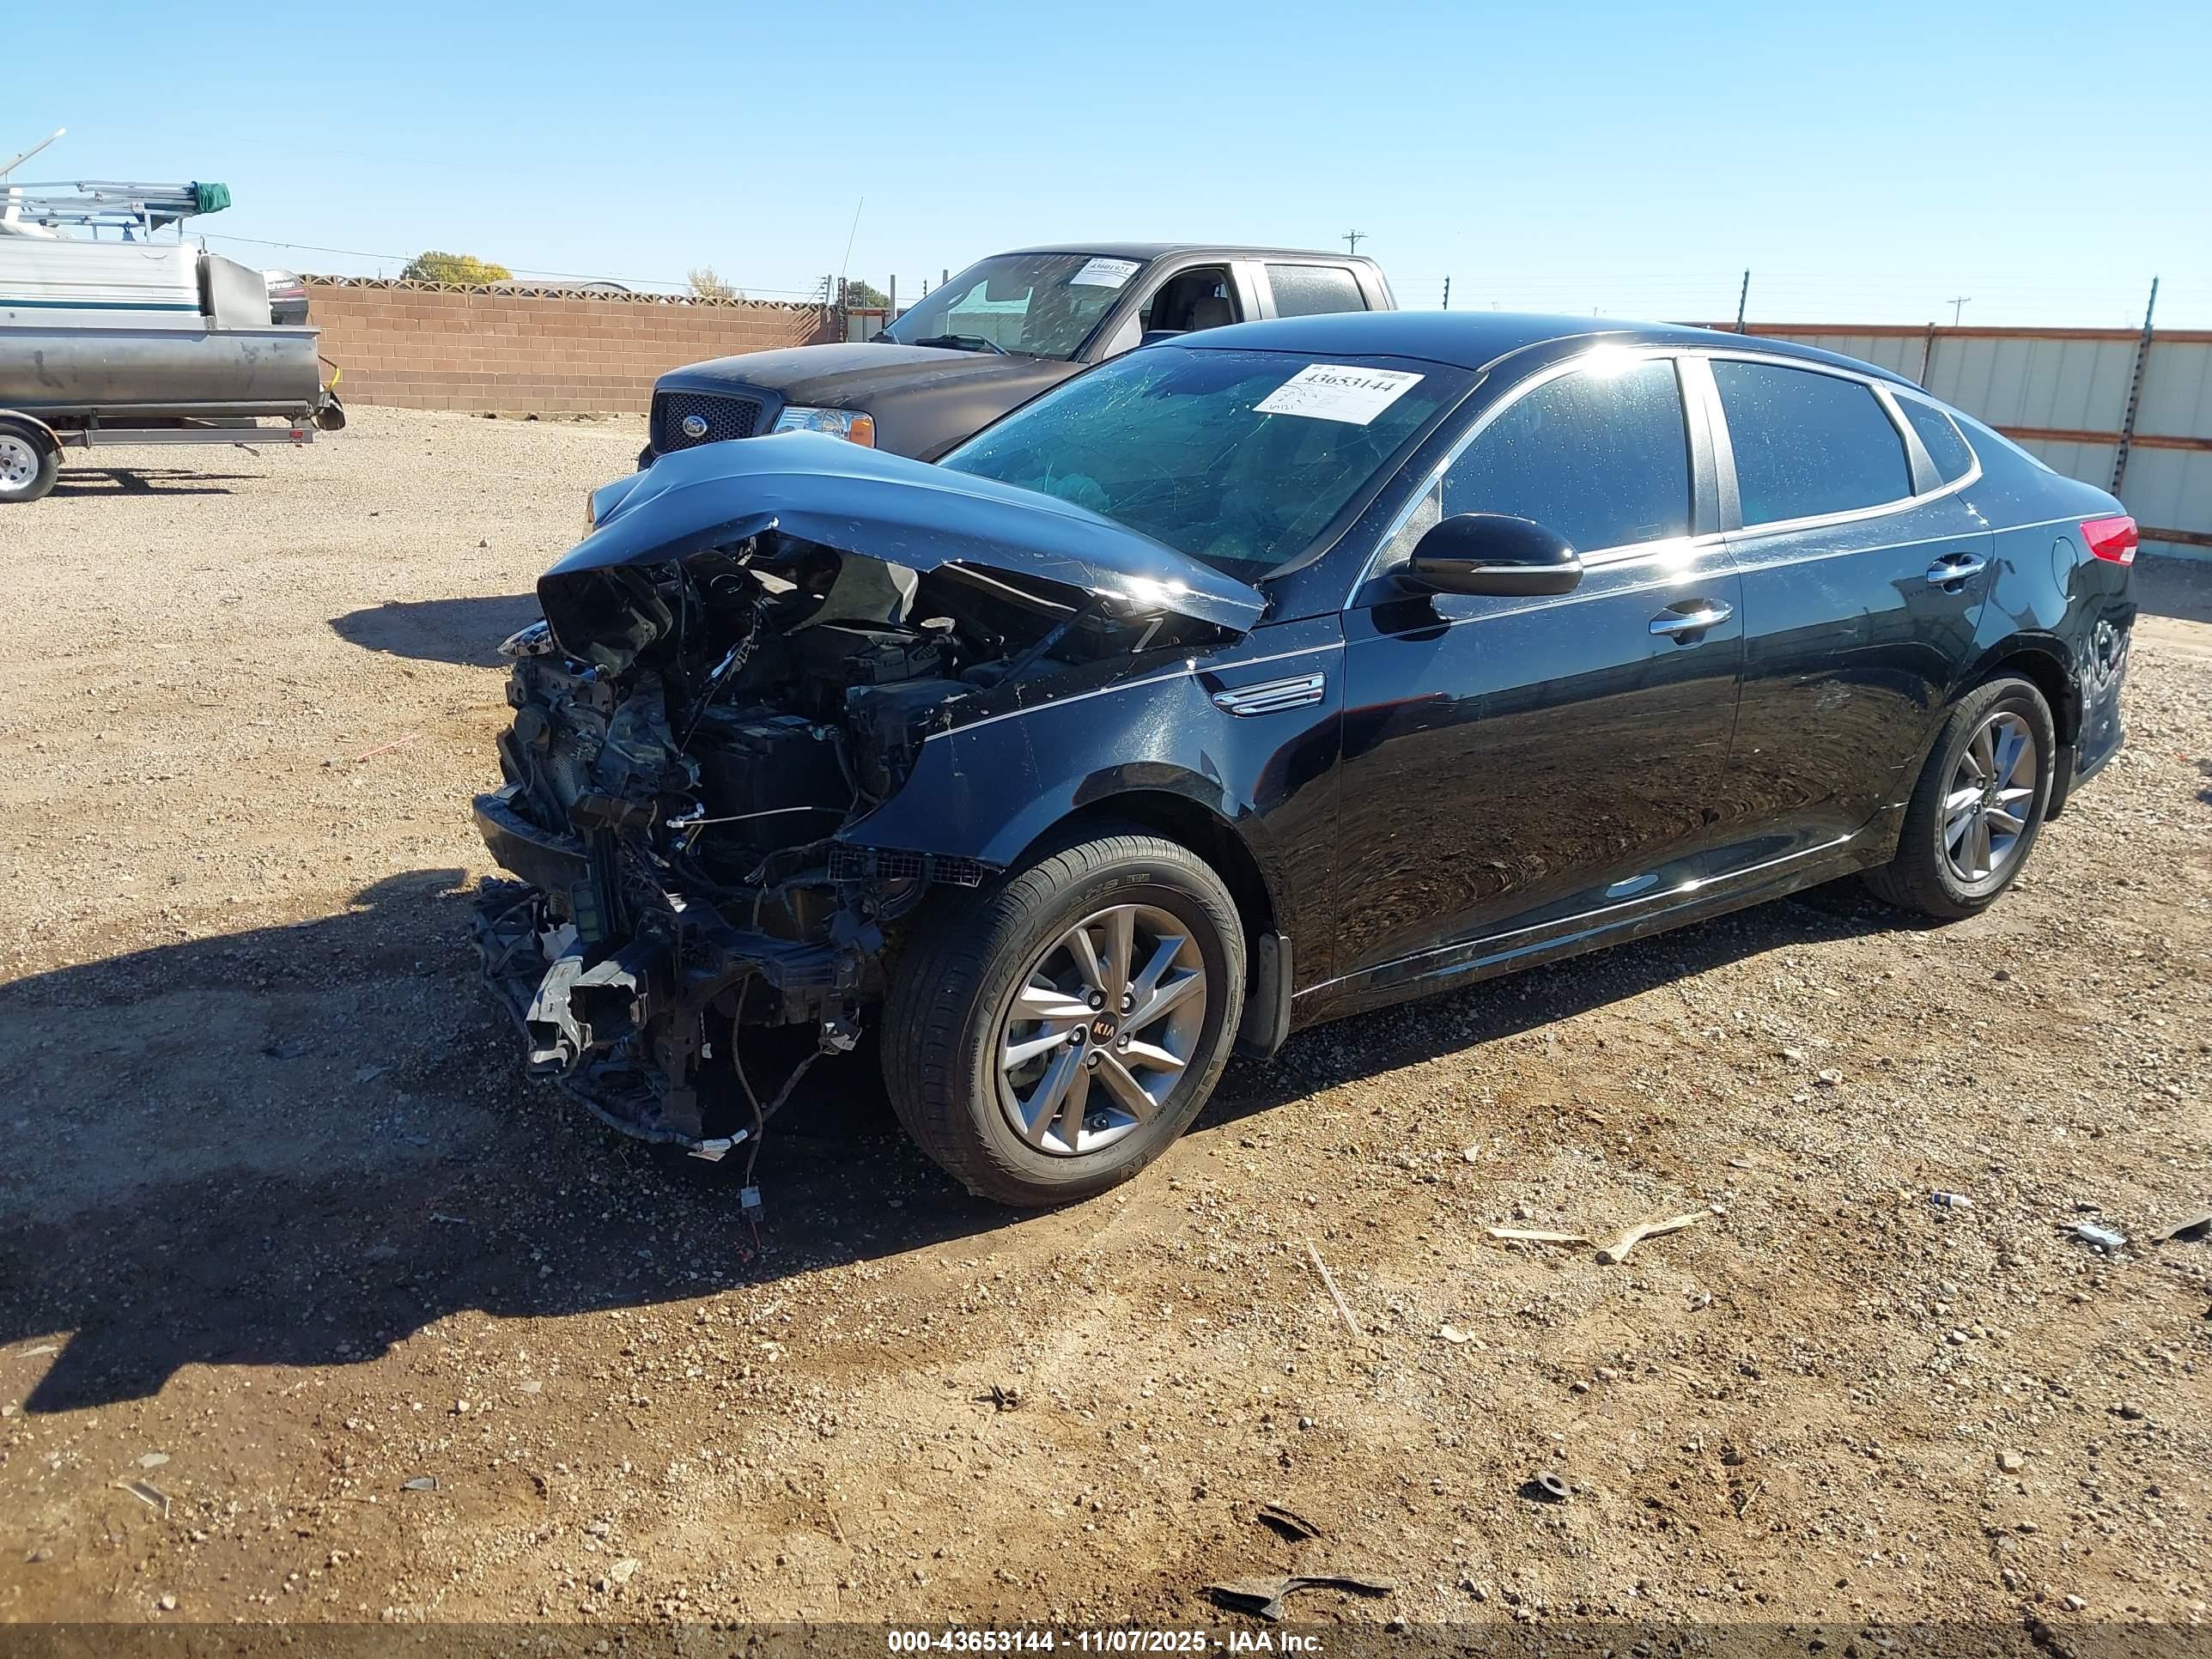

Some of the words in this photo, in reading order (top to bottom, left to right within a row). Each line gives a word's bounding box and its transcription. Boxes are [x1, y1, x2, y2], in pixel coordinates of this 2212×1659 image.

[267, 281, 295, 289] ohnson
[1304, 373, 1396, 392] 43653144
[1093, 1022, 1115, 1037] KIA
